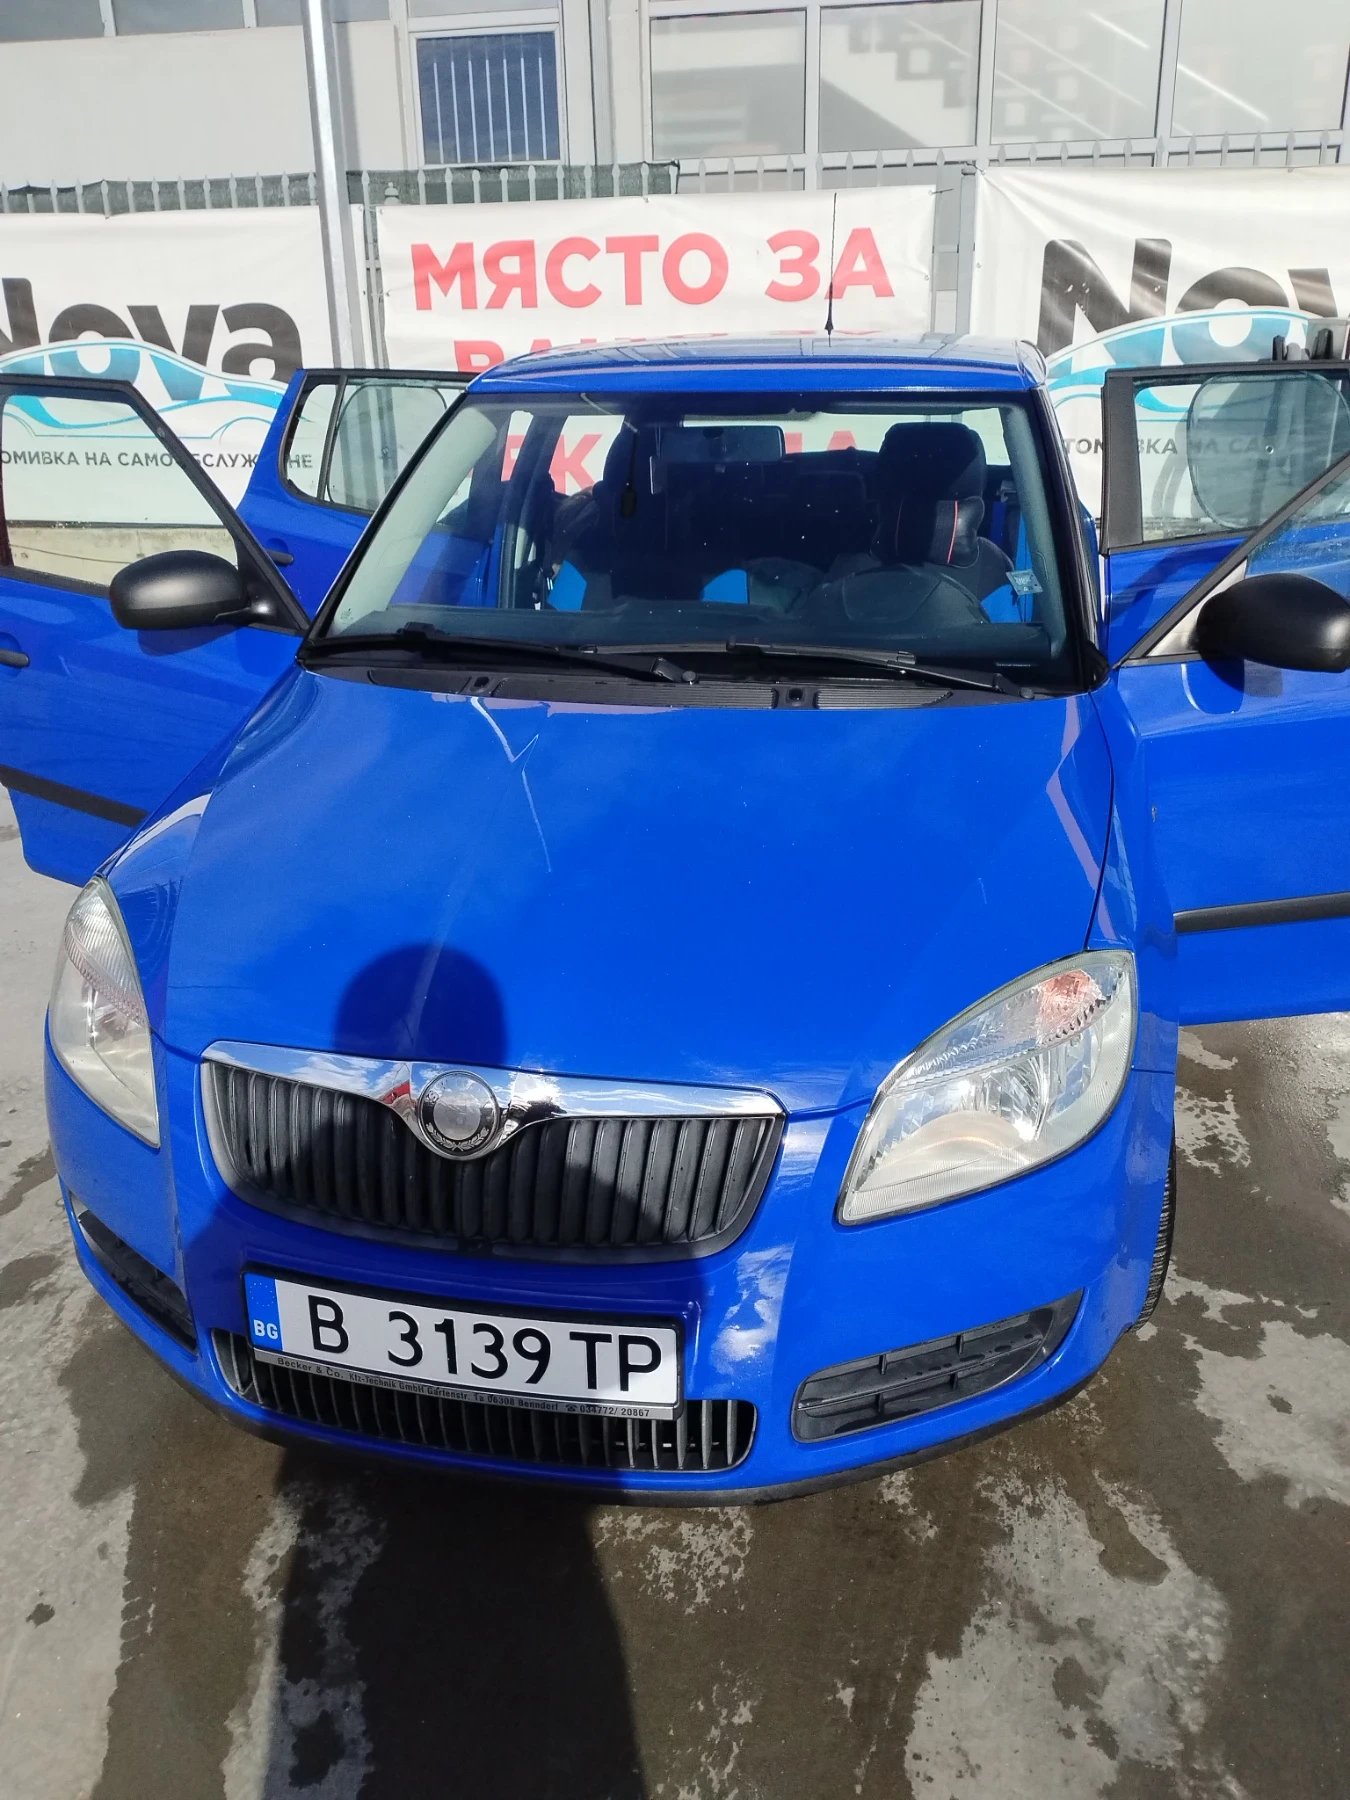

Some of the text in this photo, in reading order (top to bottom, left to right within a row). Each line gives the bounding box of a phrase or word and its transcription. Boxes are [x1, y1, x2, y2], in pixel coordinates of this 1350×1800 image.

[411, 227, 895, 311] МЯСТО ЗА
[84, 451, 112, 466] НА
[253, 1319, 278, 1341] BG
[308, 1294, 662, 1392] B 3139 TP
[277, 1357, 312, 1372] Becker
[316, 1366, 323, 1374] &
[326, 1367, 344, 1379] Co.
[399, 1381, 424, 1394] GmbH
[621, 1407, 650, 1417] 20867
